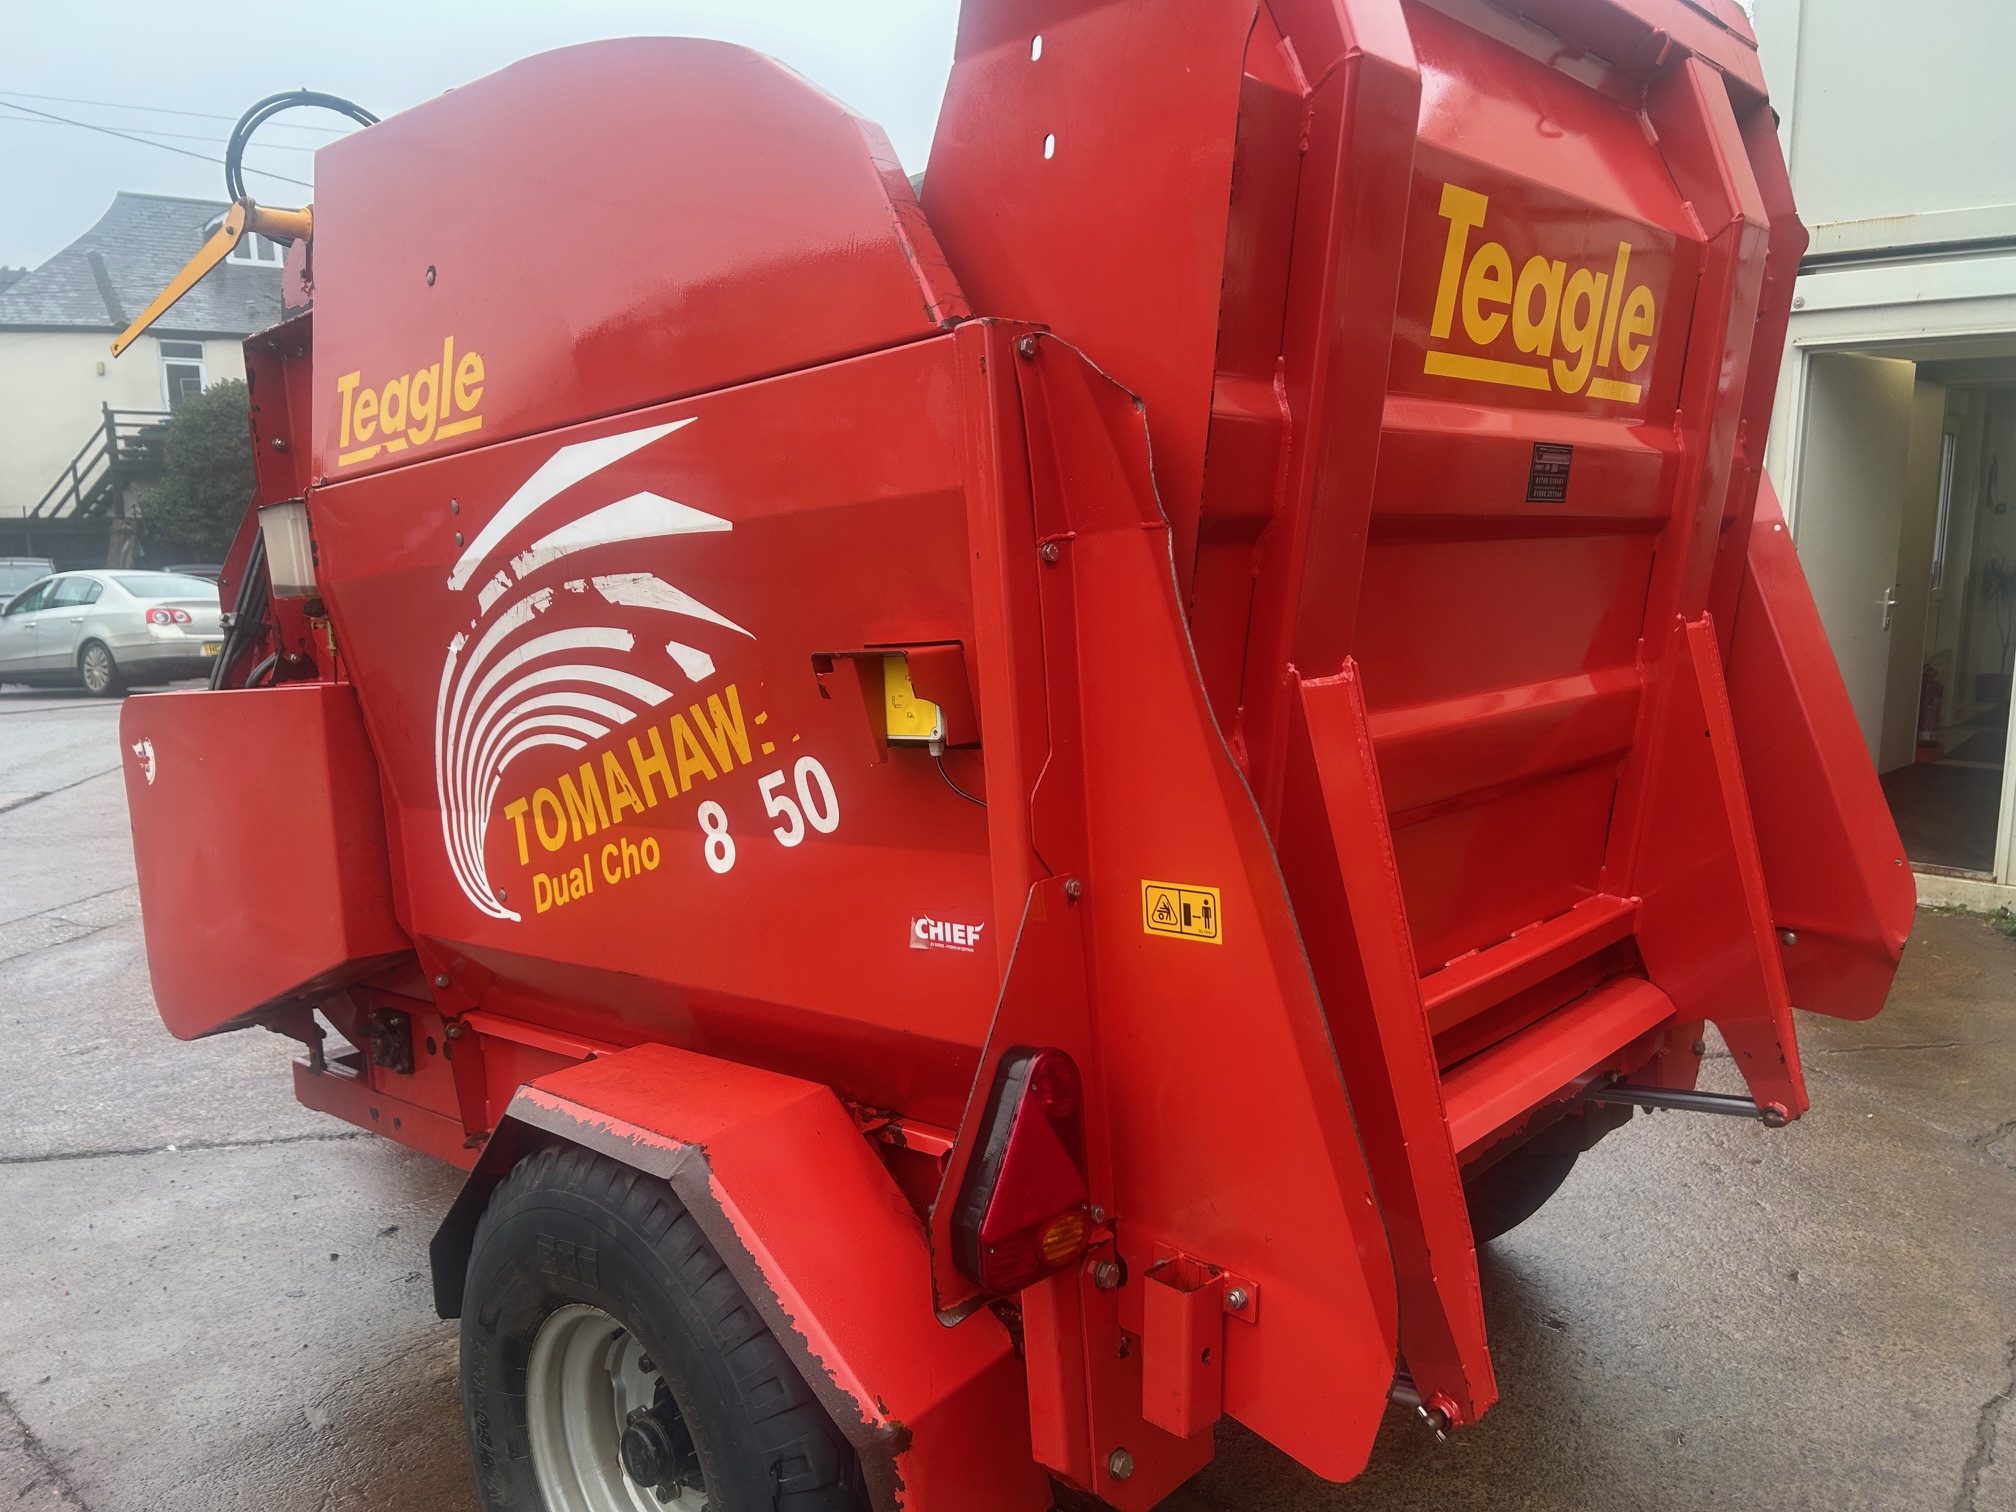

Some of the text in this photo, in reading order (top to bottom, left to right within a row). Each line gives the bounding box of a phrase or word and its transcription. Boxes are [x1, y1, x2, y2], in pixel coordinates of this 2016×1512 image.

[1430, 182, 1655, 394] Teagle
[337, 334, 485, 446] Teagle
[503, 683, 775, 866] TOMAHAW
[697, 756, 840, 874] 8 50
[533, 836, 660, 914] Dual Cho
[915, 913, 985, 947] CHIEF
[536, 1233, 600, 1290] BKT
